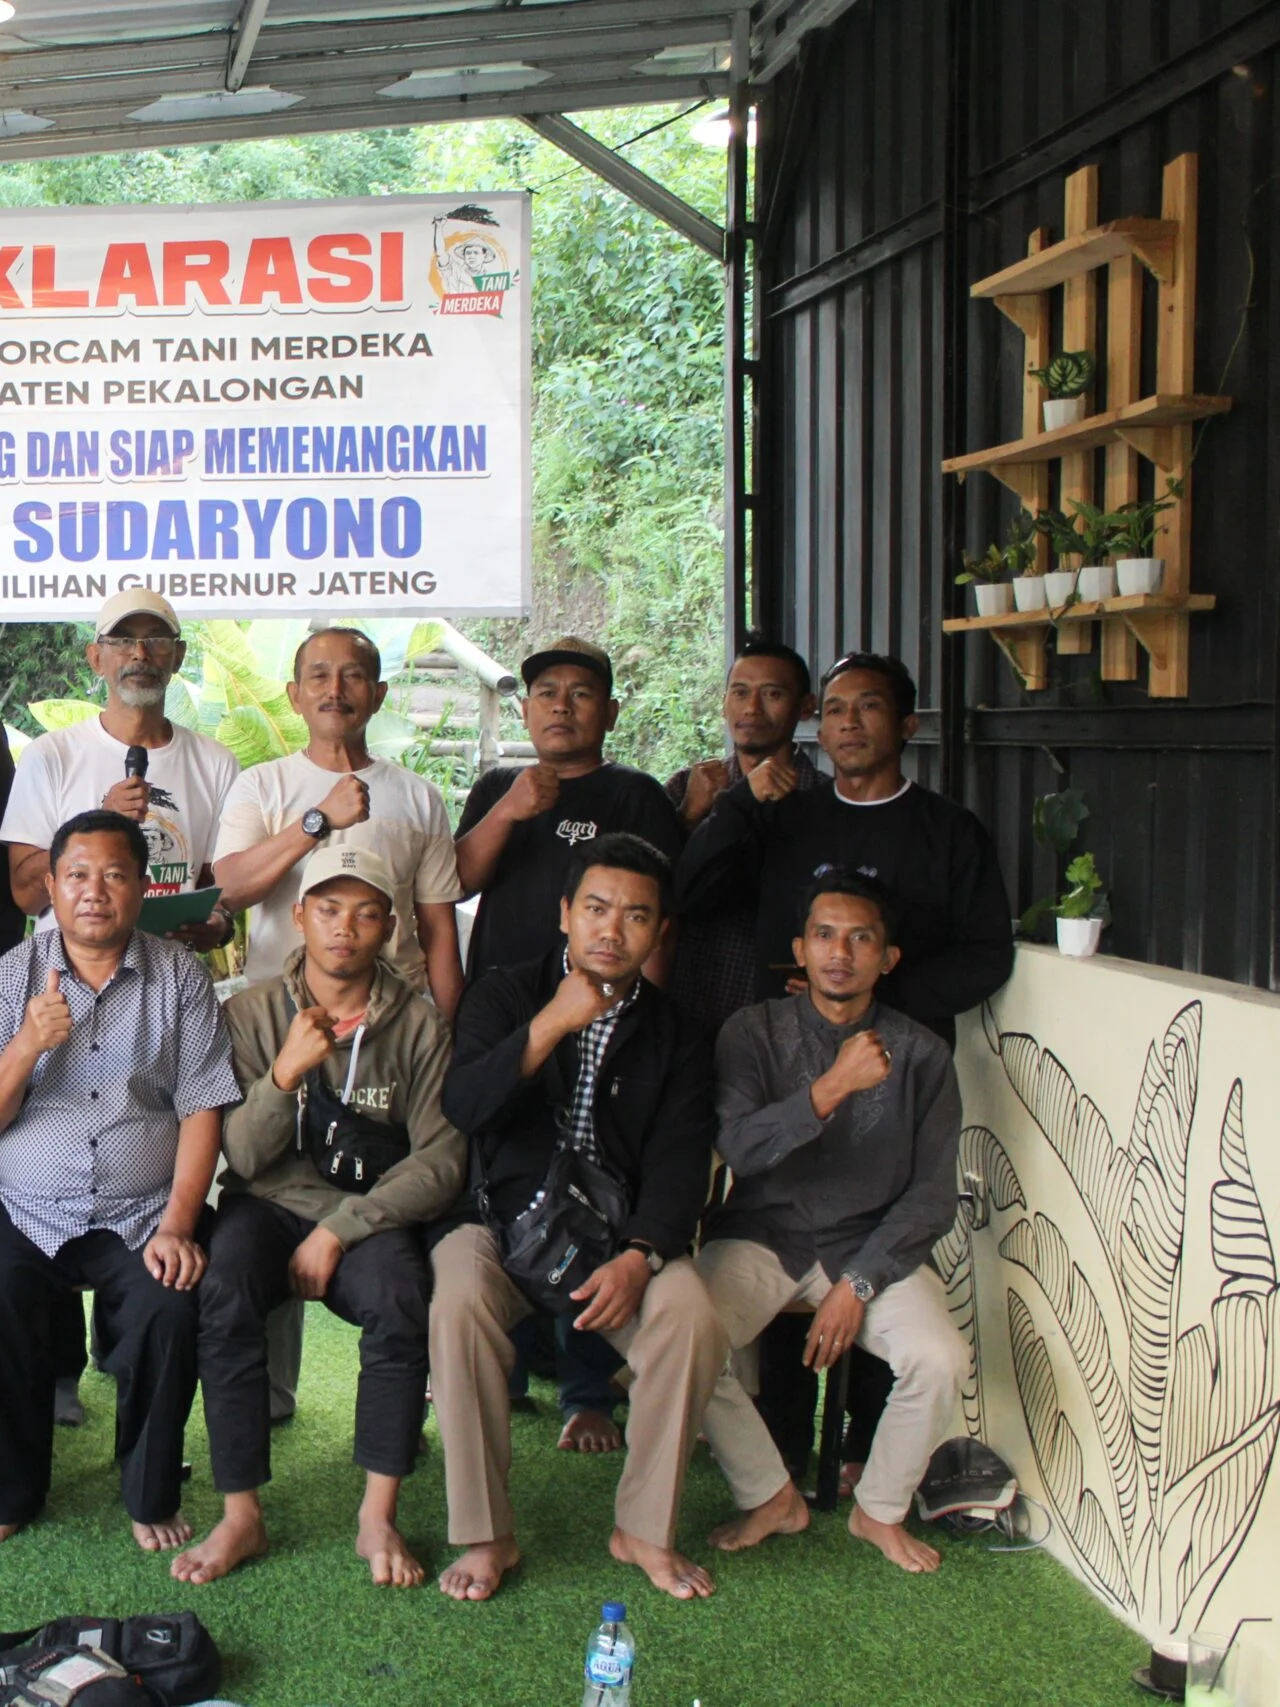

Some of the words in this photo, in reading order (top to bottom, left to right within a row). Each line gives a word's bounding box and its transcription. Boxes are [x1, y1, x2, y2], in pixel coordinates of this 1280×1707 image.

[480, 275, 508, 291] TANI
[443, 295, 500, 313] MERDEKA
[152, 336, 238, 363] TANI
[250, 331, 434, 362] MERDEKA
[103, 374, 364, 405] PEKALONGAN
[26, 430, 100, 479] DAN
[110, 428, 195, 478] SIAP
[204, 424, 488, 474] MEMENANGKAN
[13, 495, 423, 563] SUDARYONO
[118, 572, 297, 598] GUBERNUR
[308, 570, 437, 596] JATENG
[159, 866, 185, 884] TANI
[593, 1659, 622, 1673] AQUA
